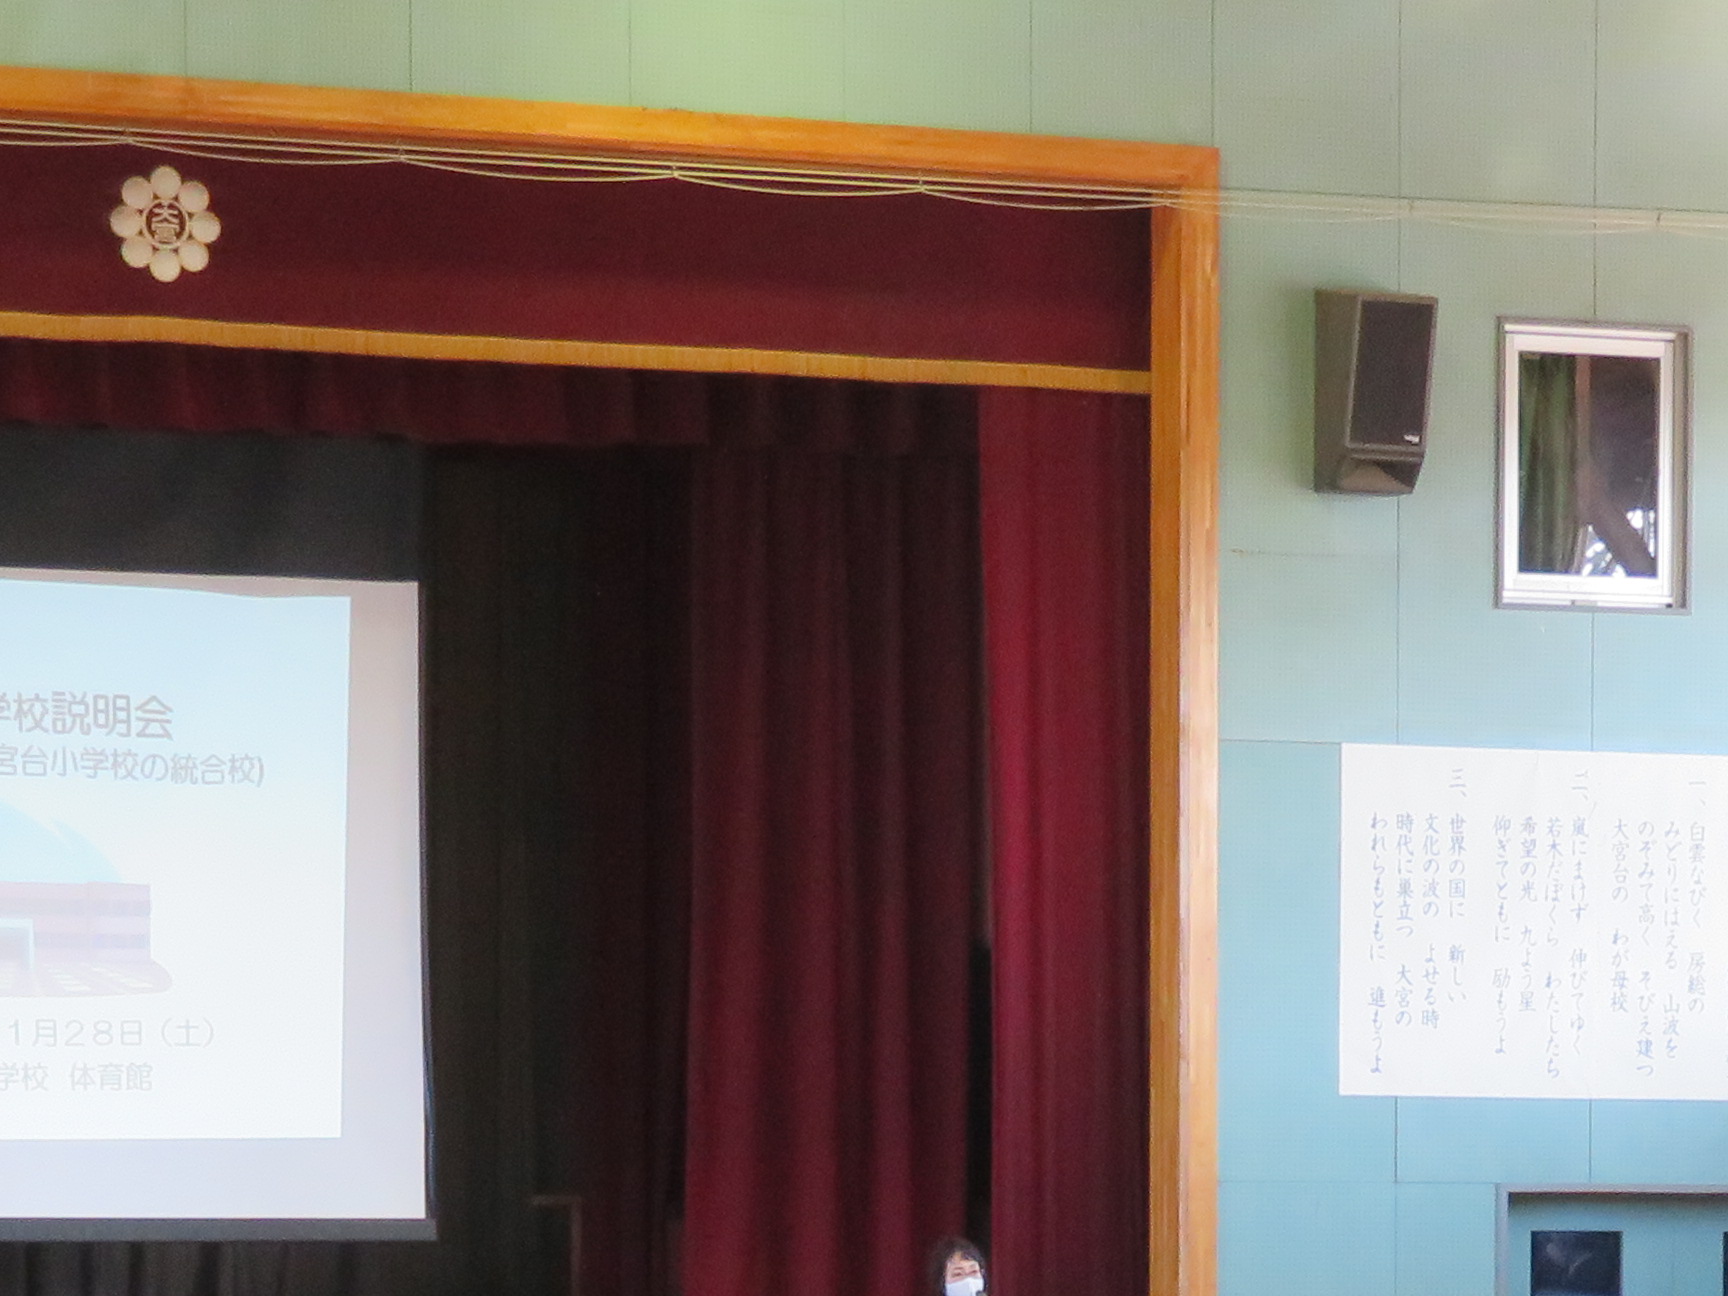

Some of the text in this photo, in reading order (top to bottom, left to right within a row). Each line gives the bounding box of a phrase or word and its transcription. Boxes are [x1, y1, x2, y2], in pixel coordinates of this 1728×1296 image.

[1519, 815, 1538, 904] 希望の光
[1395, 812, 1414, 1028] 時代に巣立つ 大宮の
[1421, 812, 1441, 1029] 文化の波の よせる時
[1610, 819, 1630, 1014] 大宮台の わが母校
[1448, 944, 1467, 1004] 新しい
[1370, 985, 1387, 1075] 進もうよ
[1544, 972, 1561, 1079] わたしたち
[68, 1061, 153, 1092] 体育館
